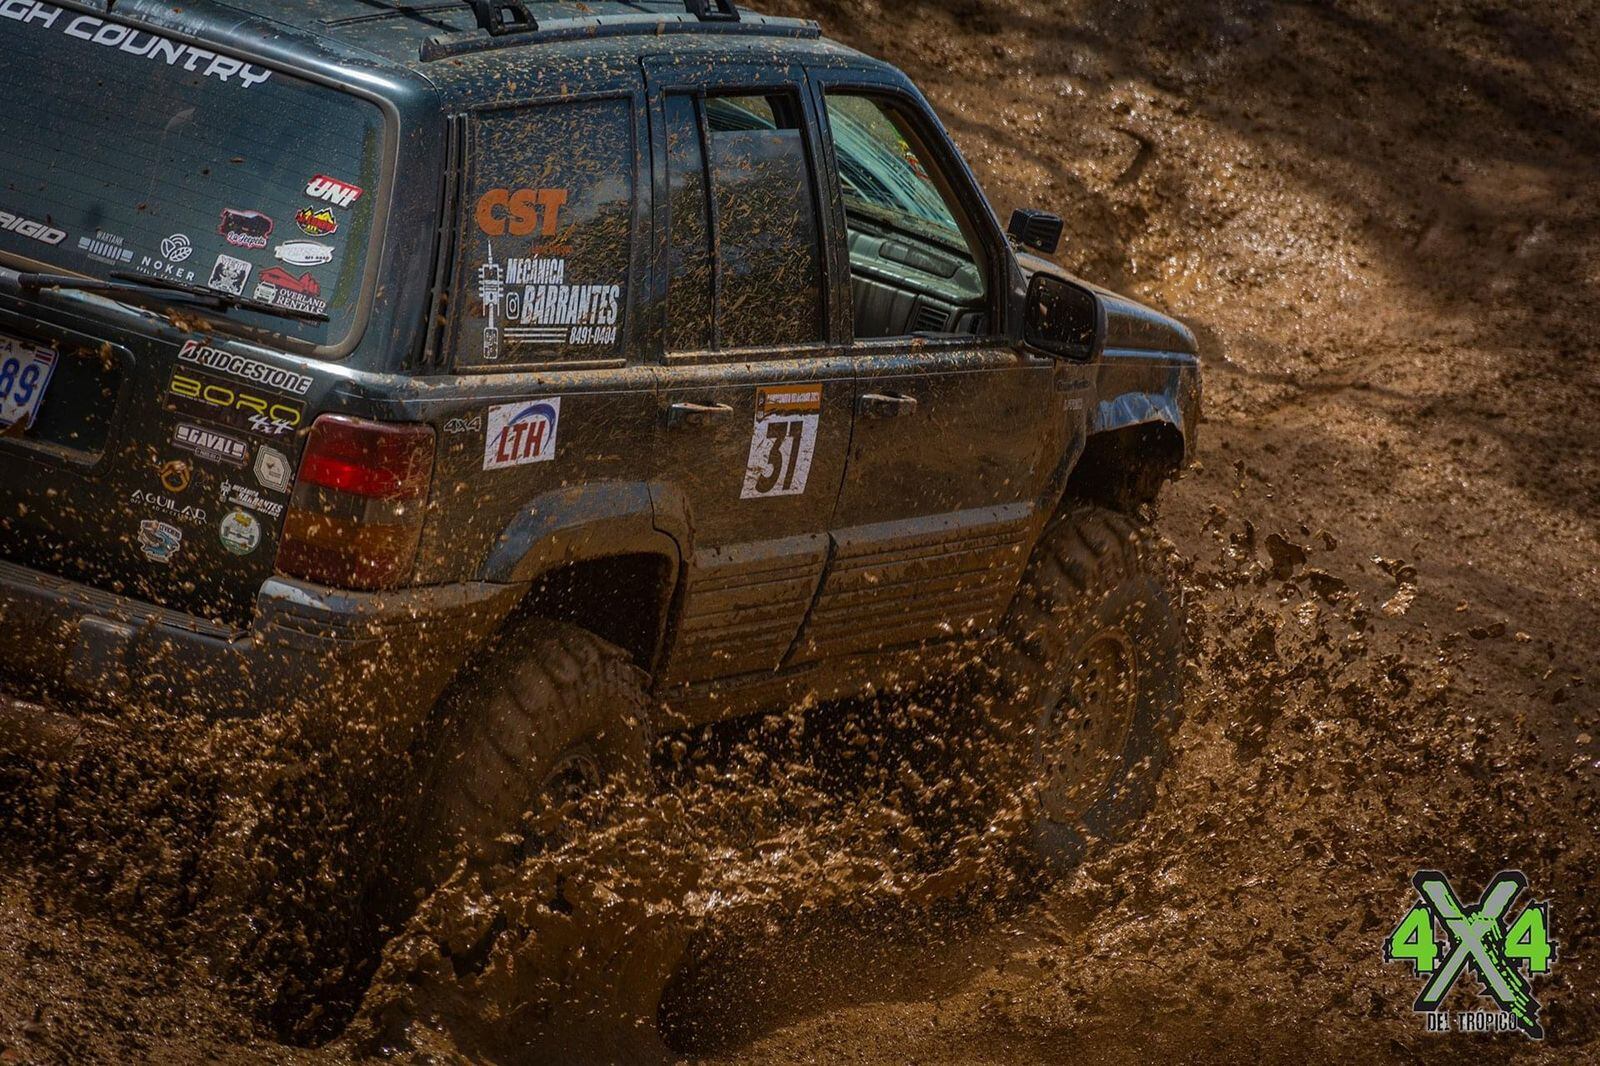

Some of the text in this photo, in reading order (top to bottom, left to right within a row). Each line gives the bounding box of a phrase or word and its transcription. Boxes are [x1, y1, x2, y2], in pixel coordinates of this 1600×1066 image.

[0, 0, 272, 88] GH COUNTRY
[306, 178, 356, 208] UNI
[475, 188, 568, 237] CST
[141, 256, 195, 281] NOKER
[505, 253, 565, 284] MECÁNICA
[279, 288, 326, 308] OVERLAND
[520, 285, 620, 325] BARRANTES
[180, 342, 312, 392] BRIDGESTONE
[171, 374, 301, 426] BORO
[496, 420, 547, 463] LTH
[755, 421, 804, 494] 31
[131, 489, 208, 524] AGUILAR
